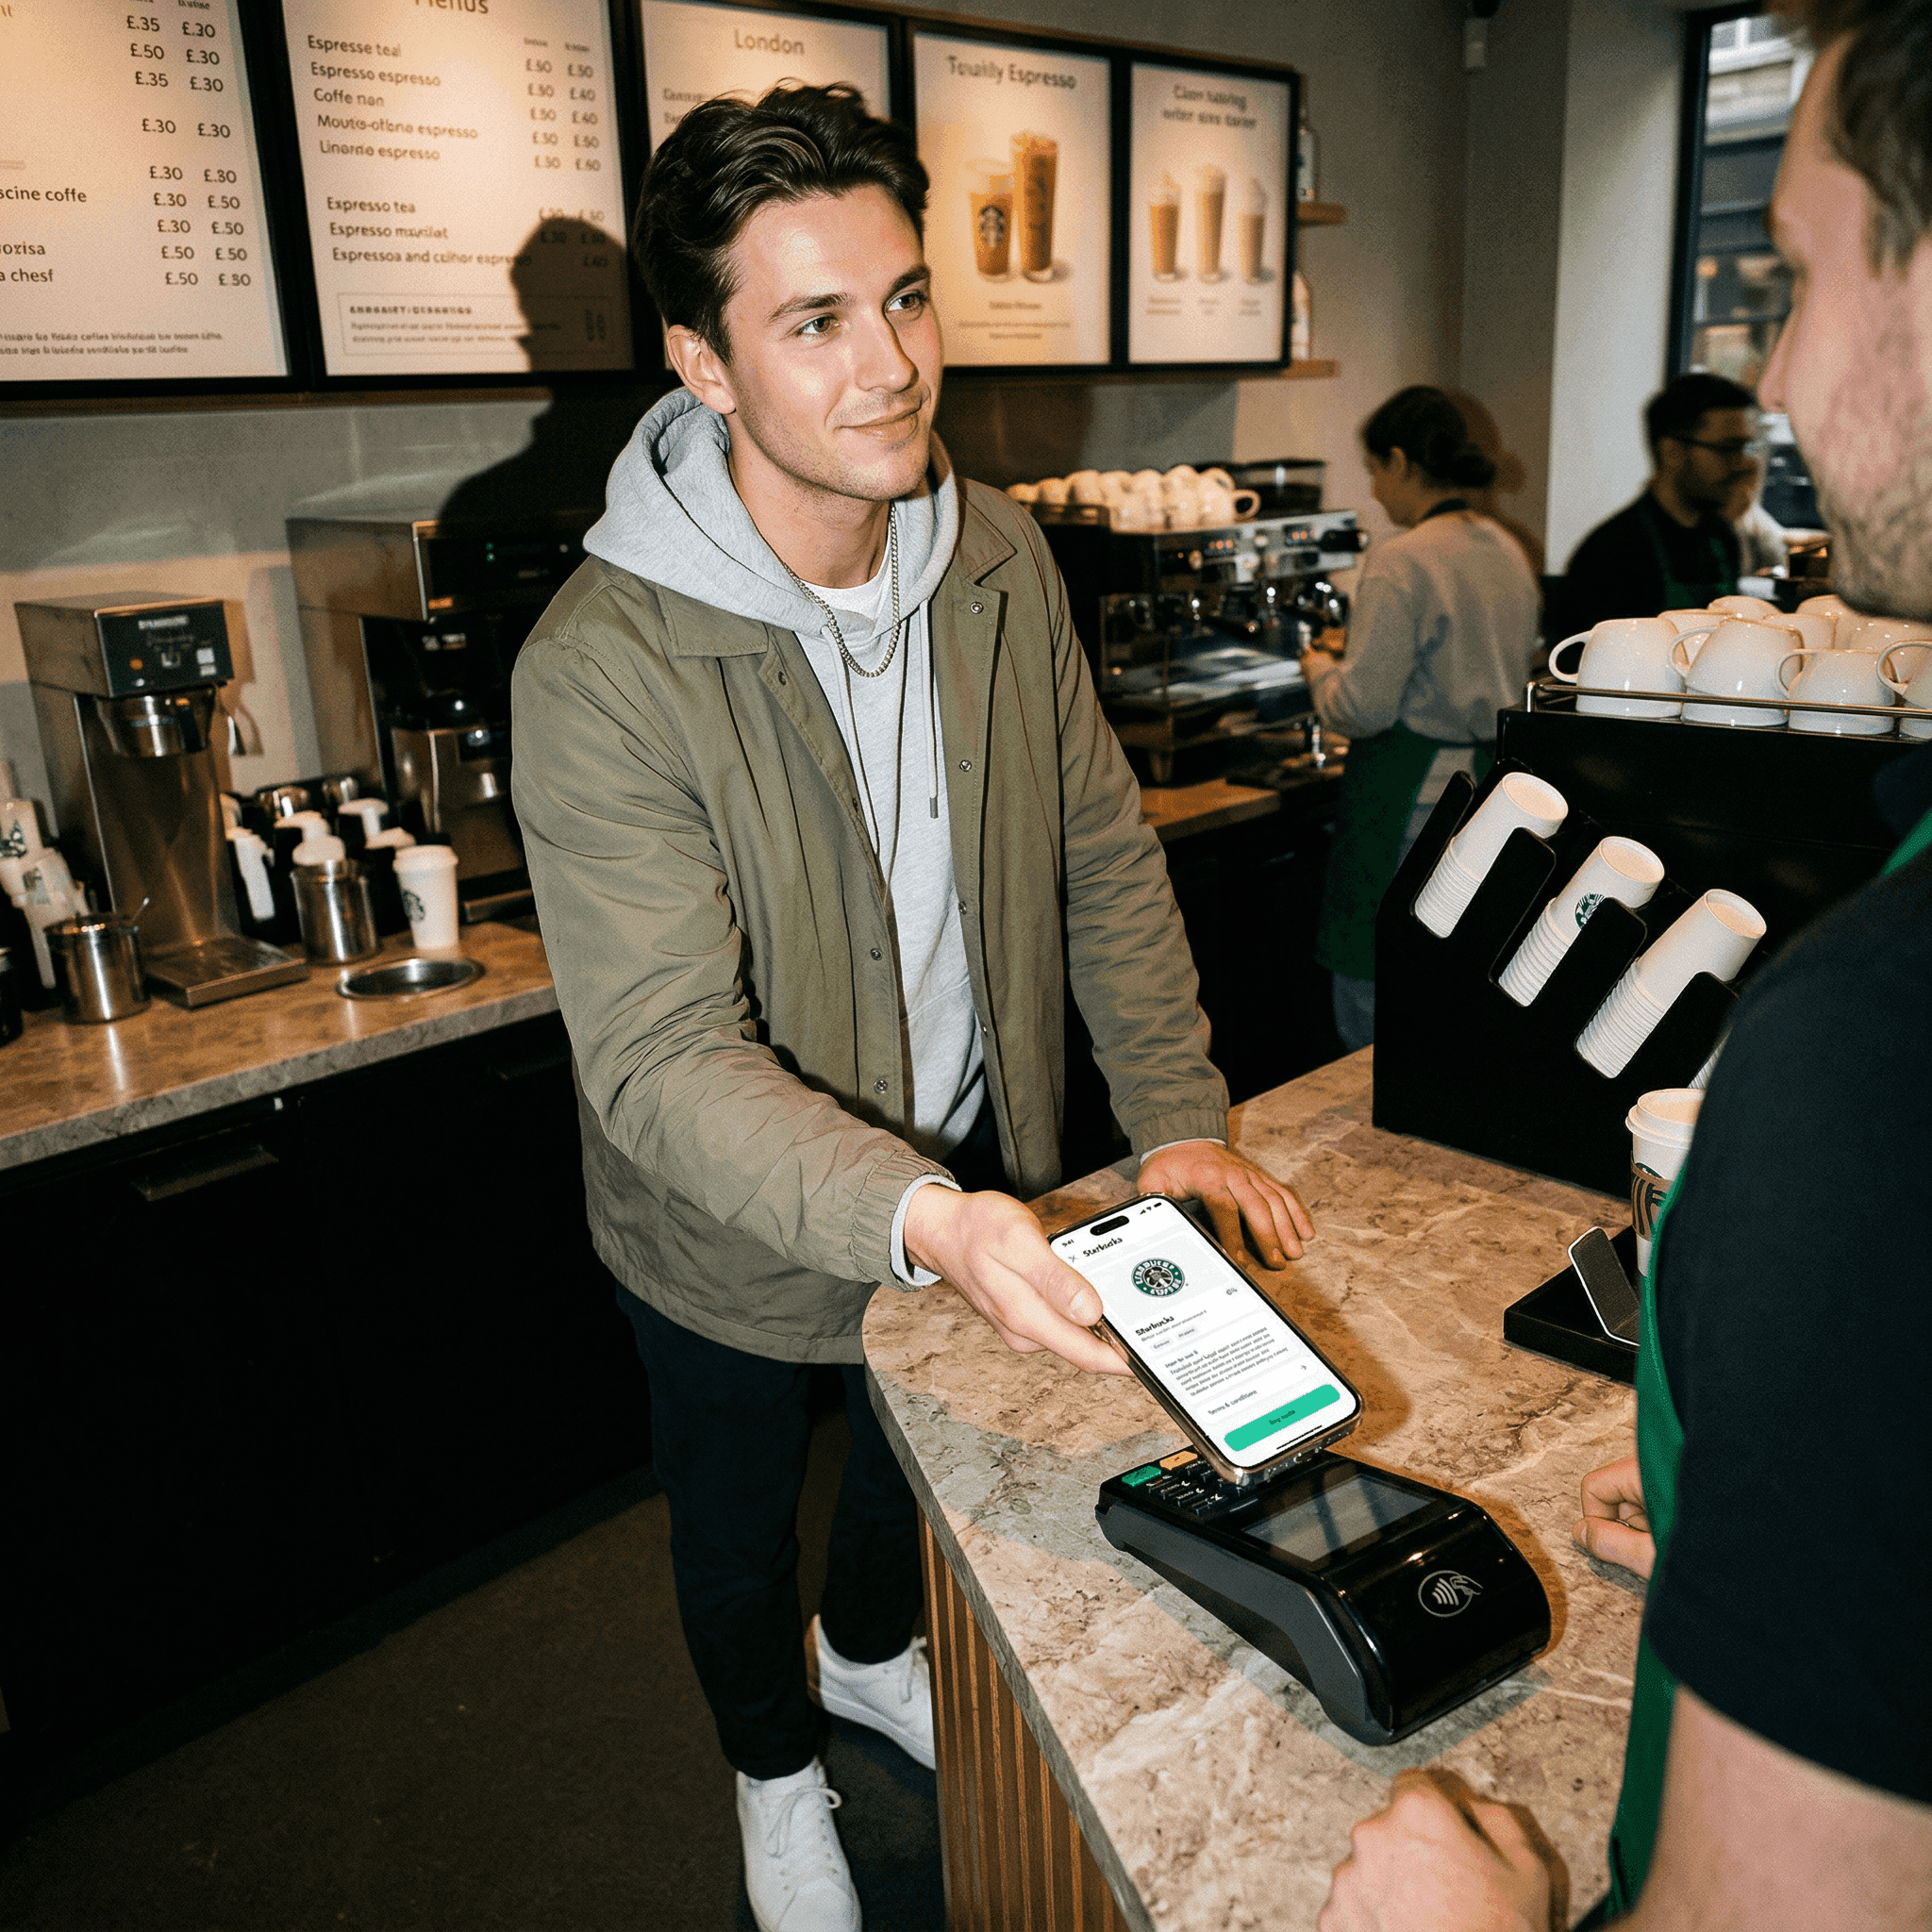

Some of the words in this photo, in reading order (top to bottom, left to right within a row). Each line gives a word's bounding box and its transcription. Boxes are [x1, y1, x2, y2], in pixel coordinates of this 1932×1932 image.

[126, 15, 160, 32] £.35
[734, 29, 805, 55] London
[130, 42, 164, 59] £.50
[186, 49, 220, 65] £.30
[135, 71, 169, 88] £.35
[190, 76, 224, 92] £.30
[311, 61, 375, 81] Espresso
[378, 71, 441, 87] espresso
[1008, 63, 1076, 91] Espresso
[314, 88, 353, 104] Coffe
[142, 118, 176, 134] £.30
[197, 123, 231, 139] £.30
[378, 146, 441, 160] espresso
[149, 166, 183, 181] £.30
[204, 169, 237, 184] £.30
[45, 188, 87, 203] coffe
[154, 192, 187, 208] £.30
[158, 220, 191, 234] £.30
[406, 251, 429, 262] and
